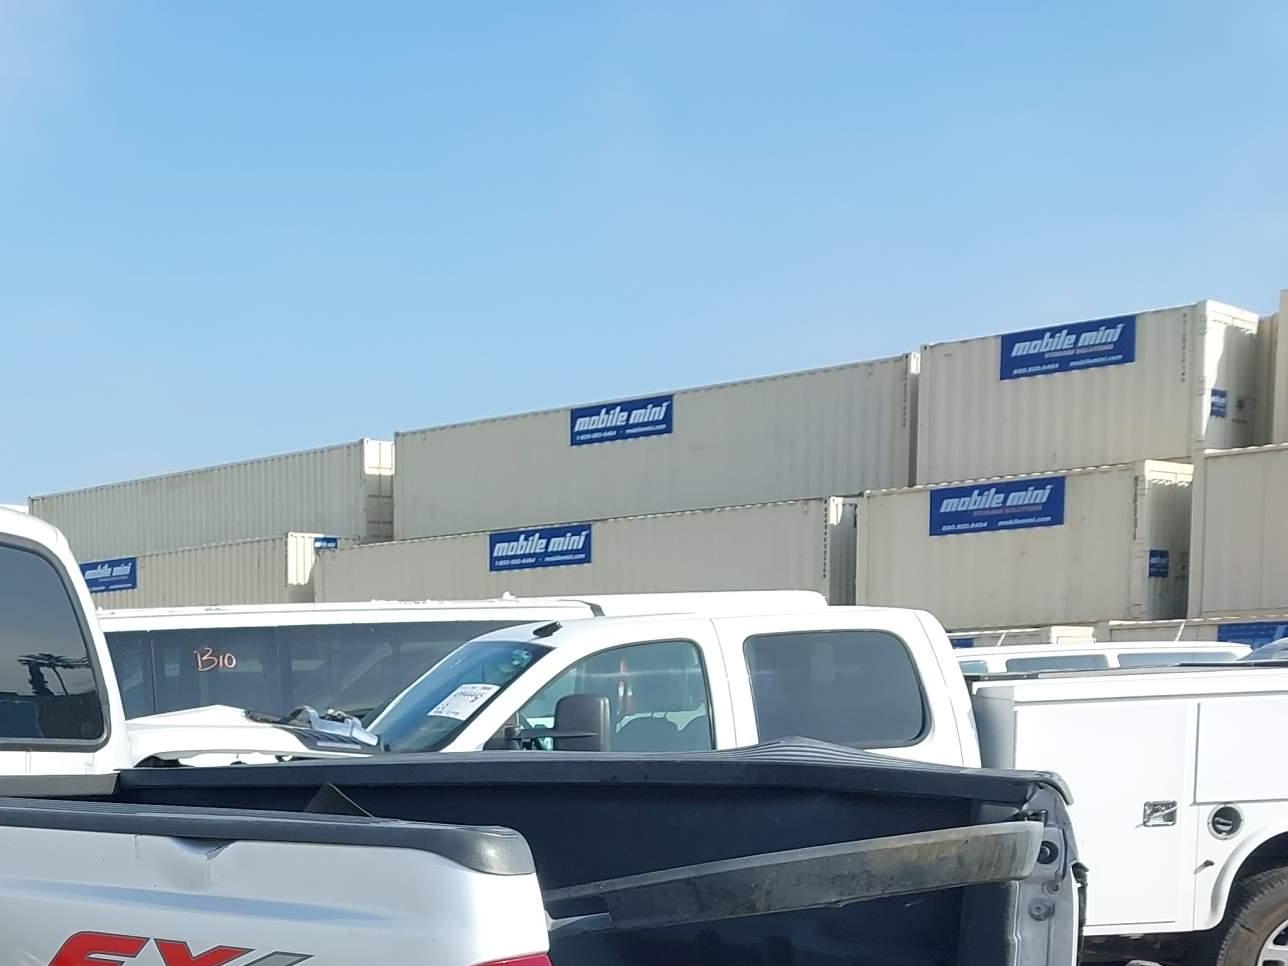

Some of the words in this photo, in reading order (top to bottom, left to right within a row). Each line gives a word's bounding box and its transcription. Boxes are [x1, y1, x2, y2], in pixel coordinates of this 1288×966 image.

[1011, 329, 1077, 357] mobile
[1078, 323, 1125, 347] mini
[574, 406, 629, 432] mobile
[629, 401, 671, 424] mini
[940, 487, 1005, 513] mobile
[1005, 485, 1053, 506] mini
[493, 533, 547, 557] mobile
[547, 530, 589, 552] mini
